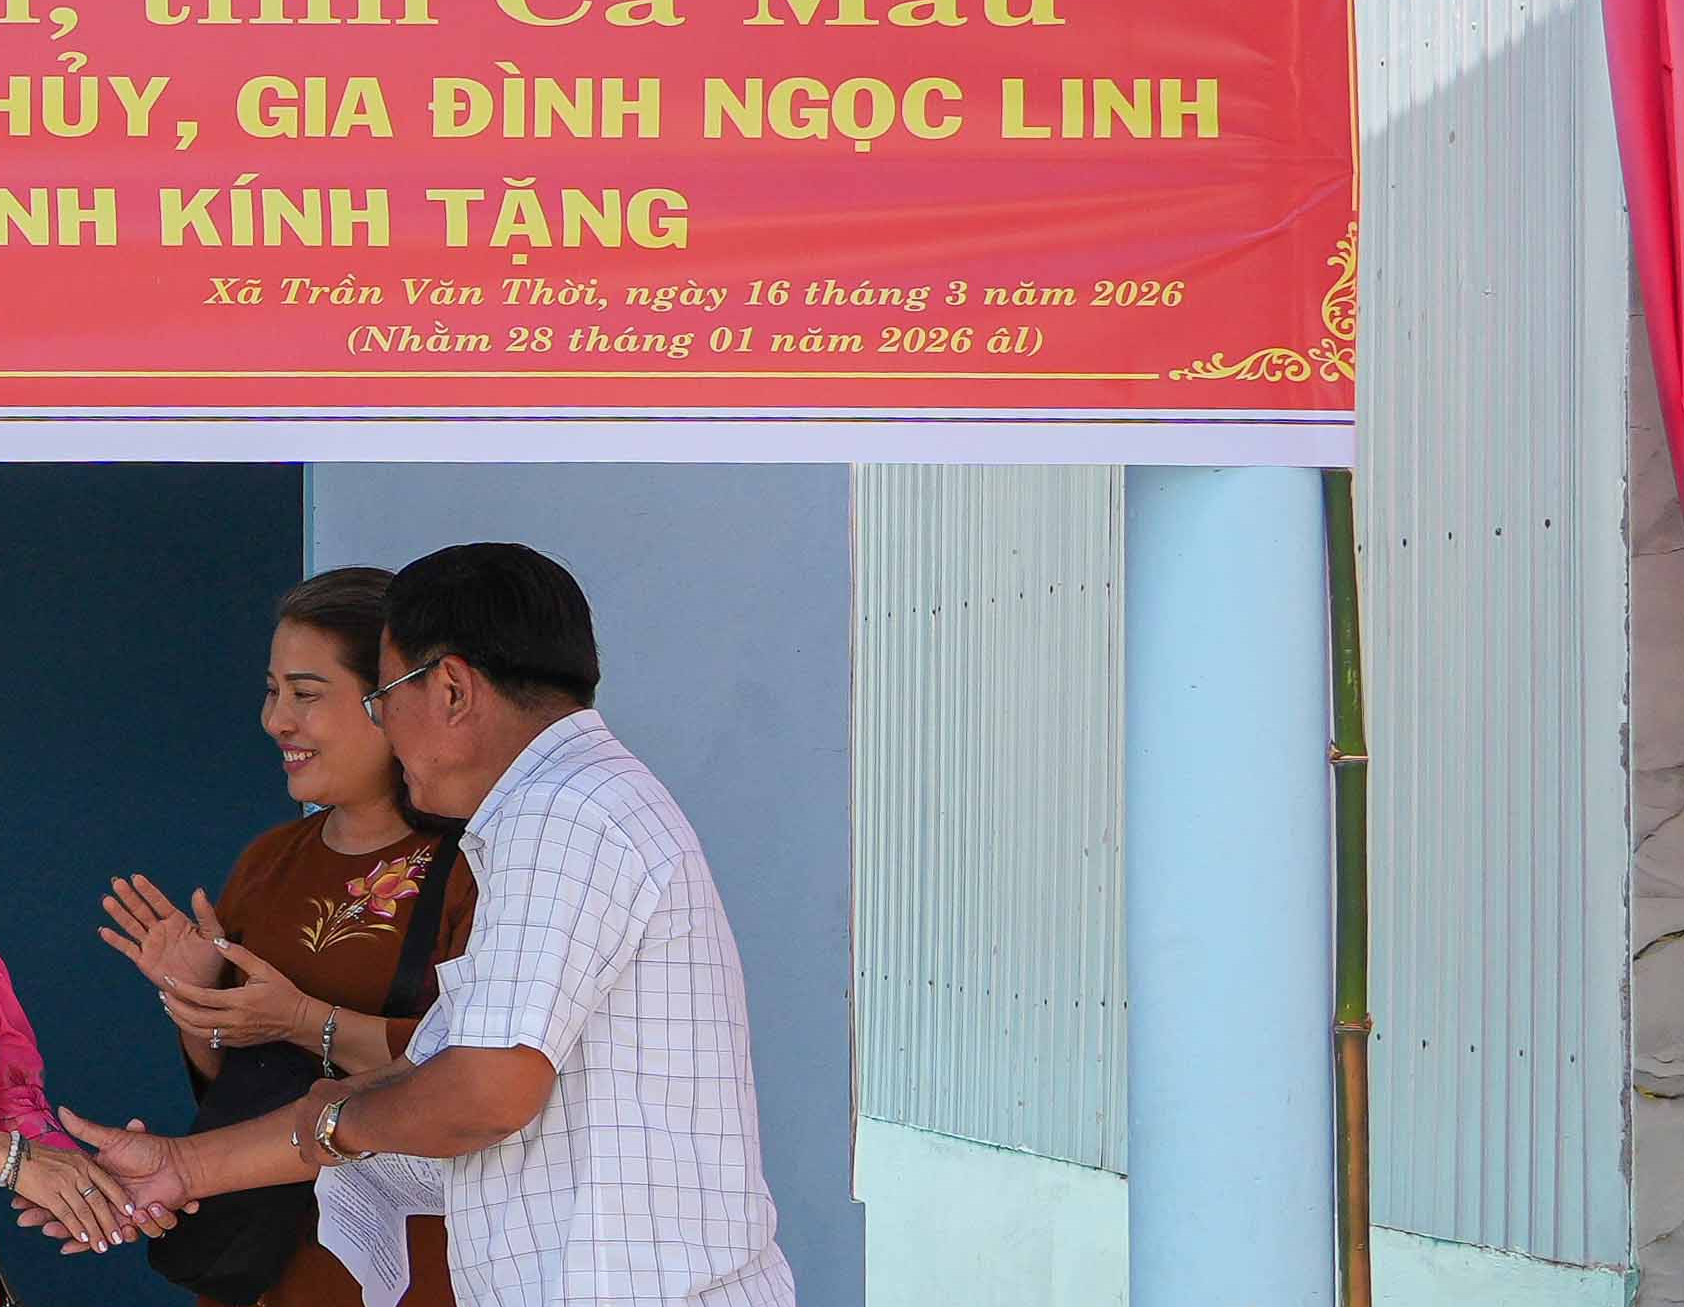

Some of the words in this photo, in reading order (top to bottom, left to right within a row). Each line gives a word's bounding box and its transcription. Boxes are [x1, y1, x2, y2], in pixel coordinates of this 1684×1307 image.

[237, 75, 394, 139] GIA
[428, 61, 661, 139] ĐÌNH
[703, 76, 964, 153] NGỌC
[1002, 78, 1220, 139] LINH
[160, 172, 390, 247] KÍNH
[426, 173, 689, 266] TẶNG
[203, 276, 265, 306] Xã
[280, 273, 386, 306] Trần
[403, 277, 486, 307] Văn
[501, 276, 609, 310] Thời,
[625, 279, 729, 313] ngày
[743, 278, 793, 307] 16
[805, 278, 933, 312] tháng
[943, 279, 969, 307] 3
[983, 280, 1079, 308] năm
[1088, 279, 1186, 308] 2026
[346, 320, 494, 354] (Nhằm
[505, 326, 555, 354] 28
[568, 324, 697, 360] tháng
[709, 325, 755, 354] 01
[769, 327, 866, 354] năm
[875, 325, 976, 355] 2026
[985, 325, 1045, 357] âl)
